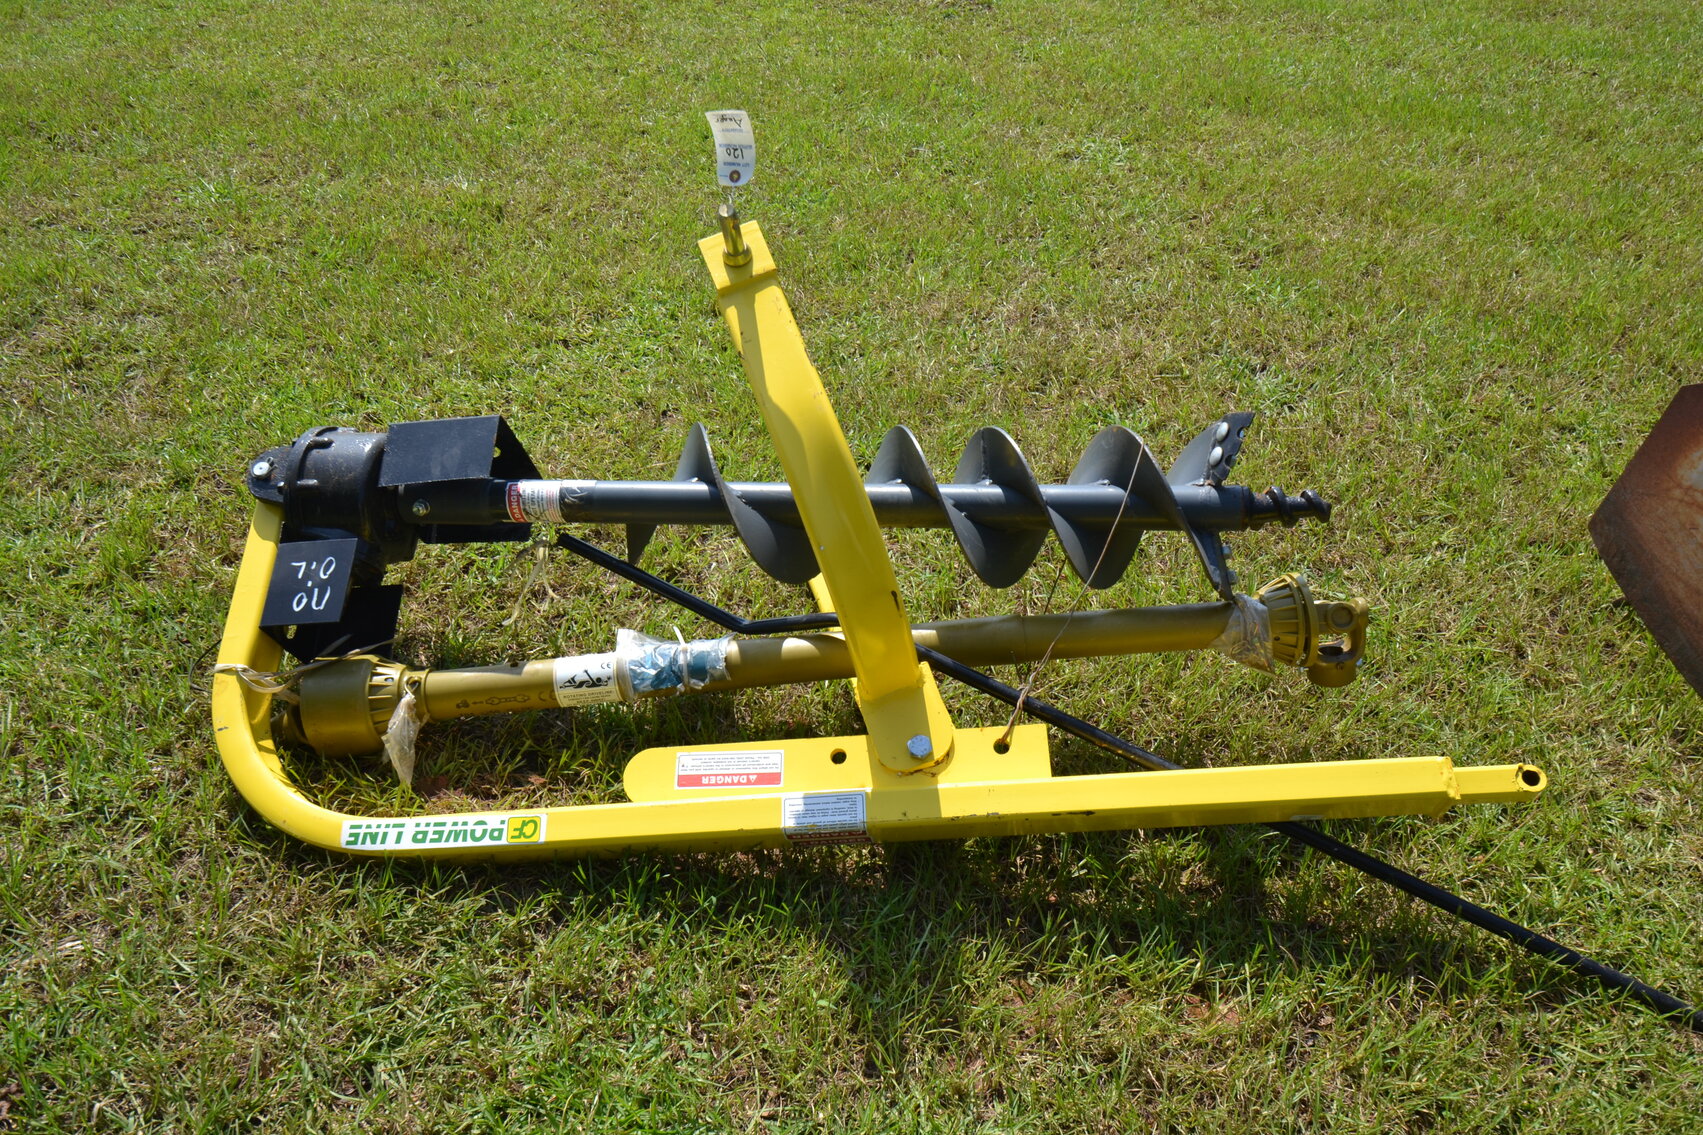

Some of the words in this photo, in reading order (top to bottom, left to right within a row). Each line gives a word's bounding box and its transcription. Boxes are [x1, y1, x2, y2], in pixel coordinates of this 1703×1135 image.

[726, 147, 744, 159] 120
[511, 485, 521, 519] DANGER
[701, 775, 748, 784] DANGER
[345, 823, 406, 846] LINE
[411, 819, 506, 844] POWER
[510, 819, 539, 840] CF
